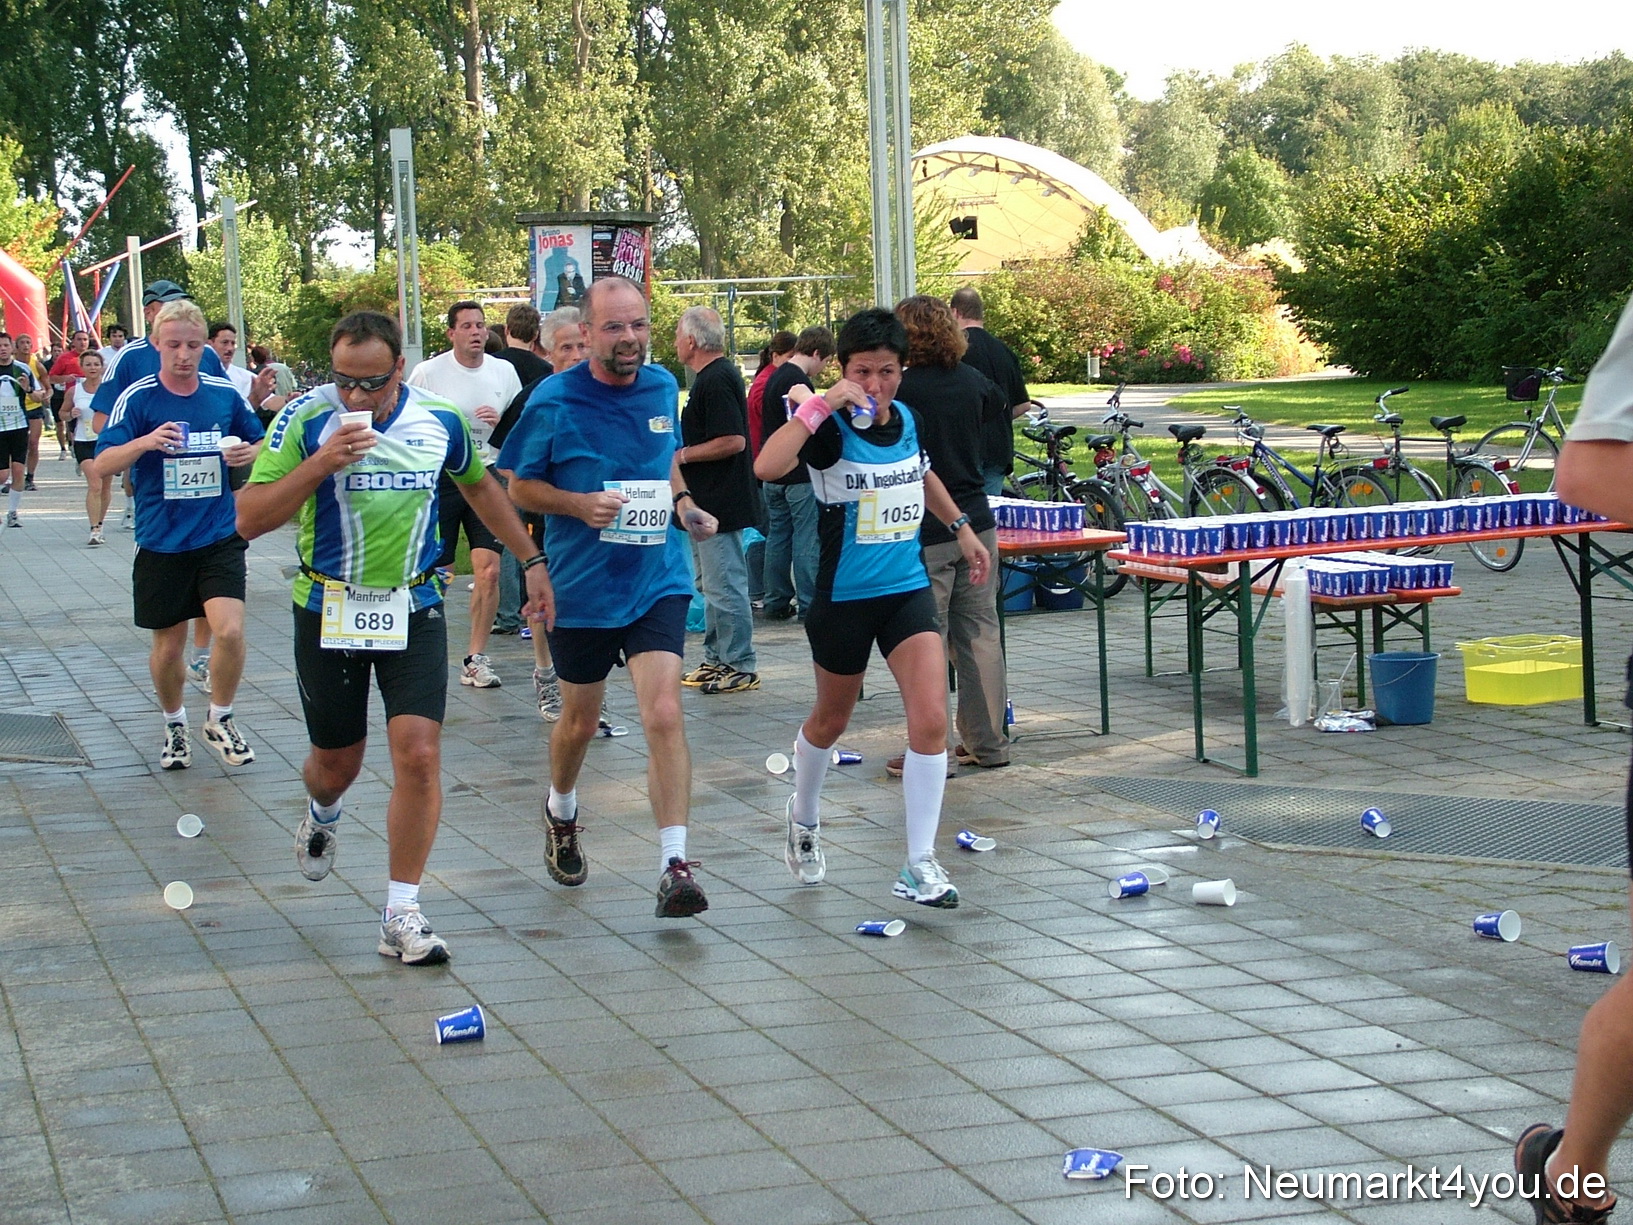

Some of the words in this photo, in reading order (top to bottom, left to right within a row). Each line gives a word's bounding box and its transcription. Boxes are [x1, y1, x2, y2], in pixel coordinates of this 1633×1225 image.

[616, 241, 645, 271] ROCK
[269, 395, 317, 449] BOCK
[181, 472, 216, 486] 2471
[345, 469, 436, 491] BOCK
[846, 473, 868, 489] DJK
[625, 487, 656, 499] Helmut
[626, 509, 667, 527] 2080
[881, 503, 920, 524] 1052
[347, 589, 391, 602] Manfred
[354, 611, 394, 631] 689
